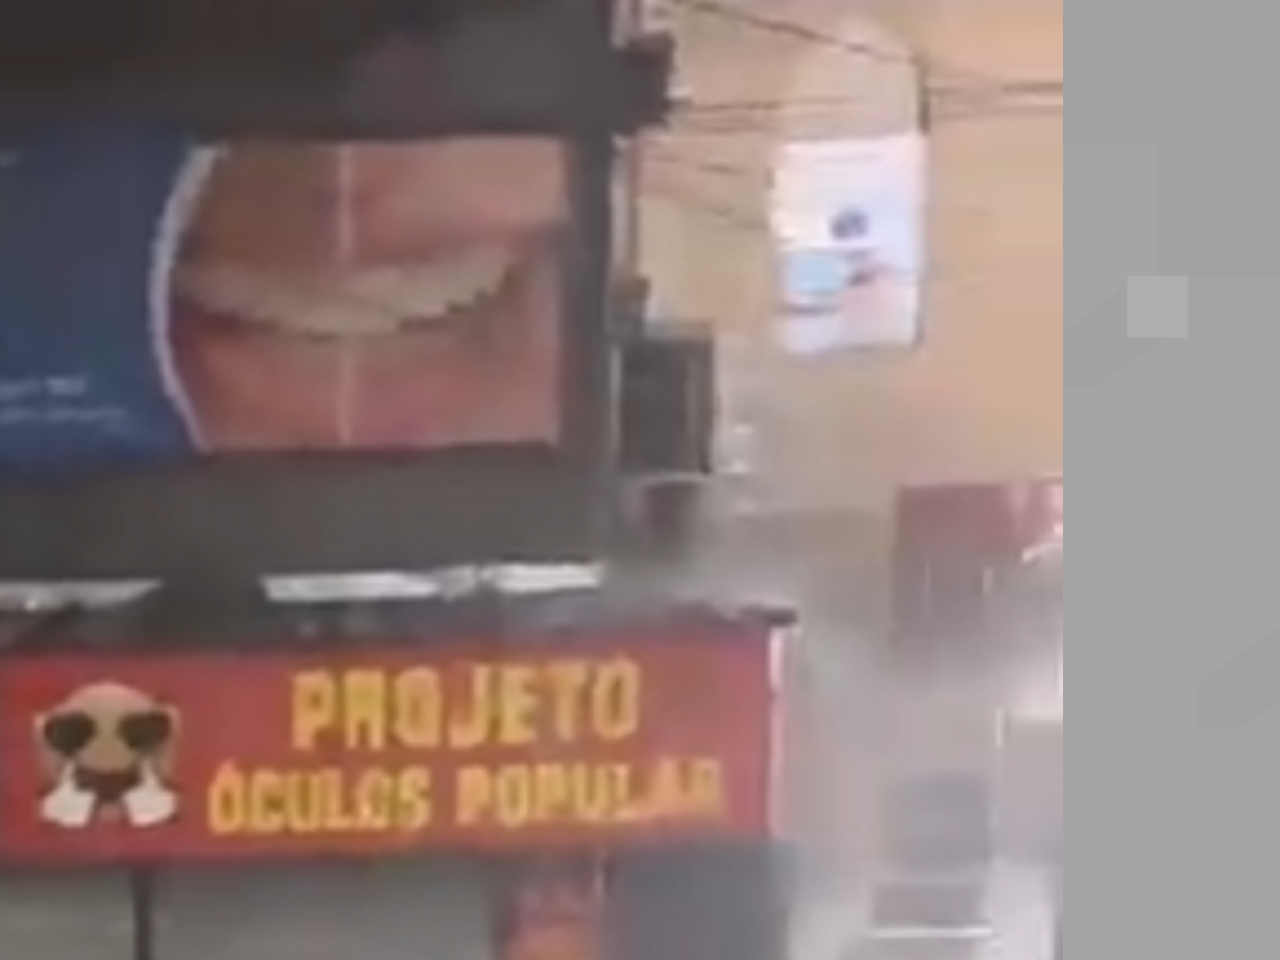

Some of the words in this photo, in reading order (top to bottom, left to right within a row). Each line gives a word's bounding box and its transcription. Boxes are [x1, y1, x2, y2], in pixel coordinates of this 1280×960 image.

[291, 656, 641, 751] PROJETO
[207, 760, 432, 834] ÓCULOS
[455, 757, 723, 827] POPULAR
